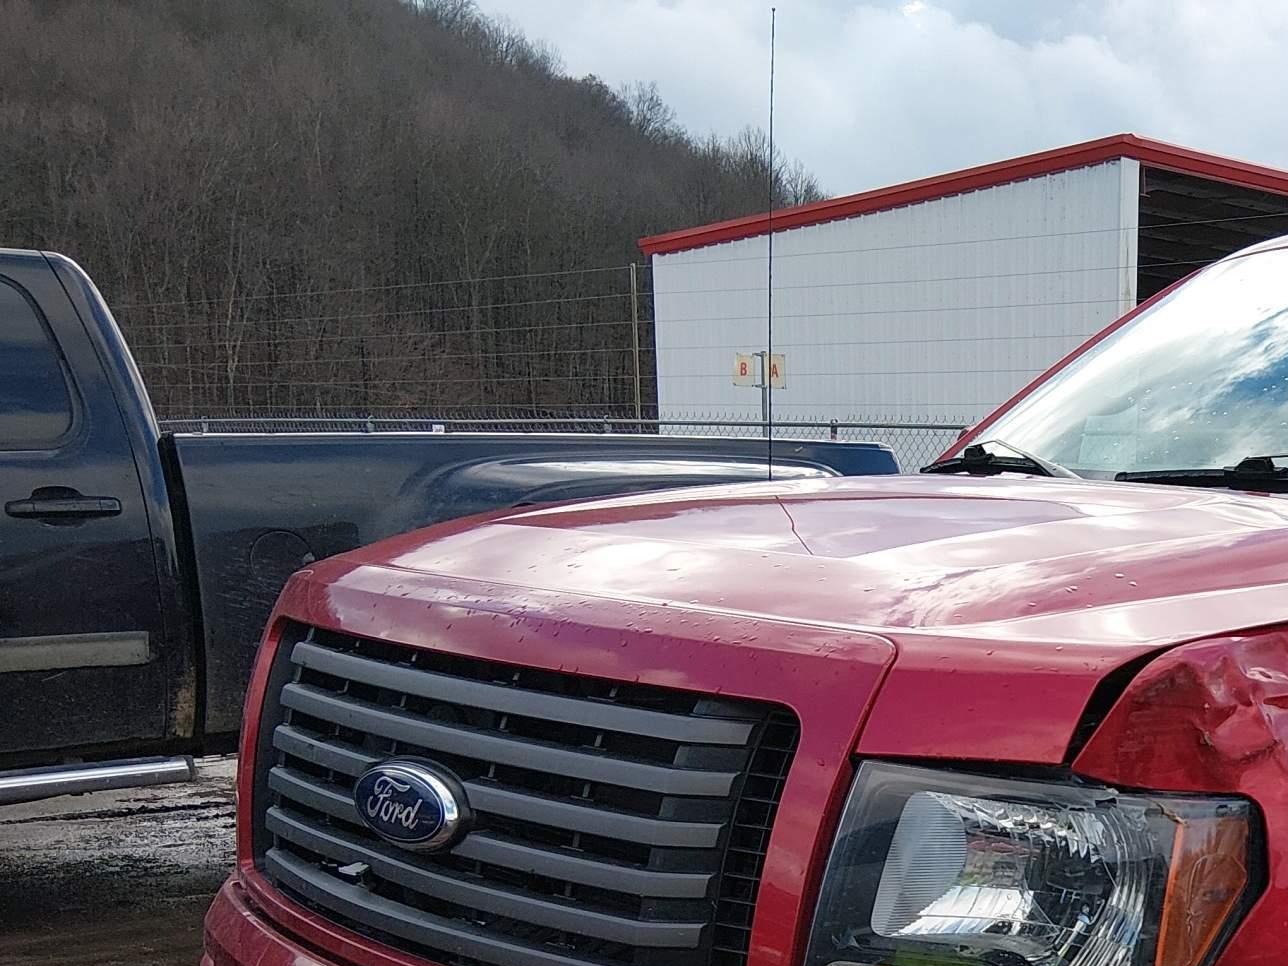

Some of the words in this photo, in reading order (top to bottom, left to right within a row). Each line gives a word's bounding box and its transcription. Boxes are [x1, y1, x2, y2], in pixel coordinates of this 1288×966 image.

[740, 362, 747, 376] B
[771, 363, 779, 378] A
[367, 775, 423, 829] Ford
